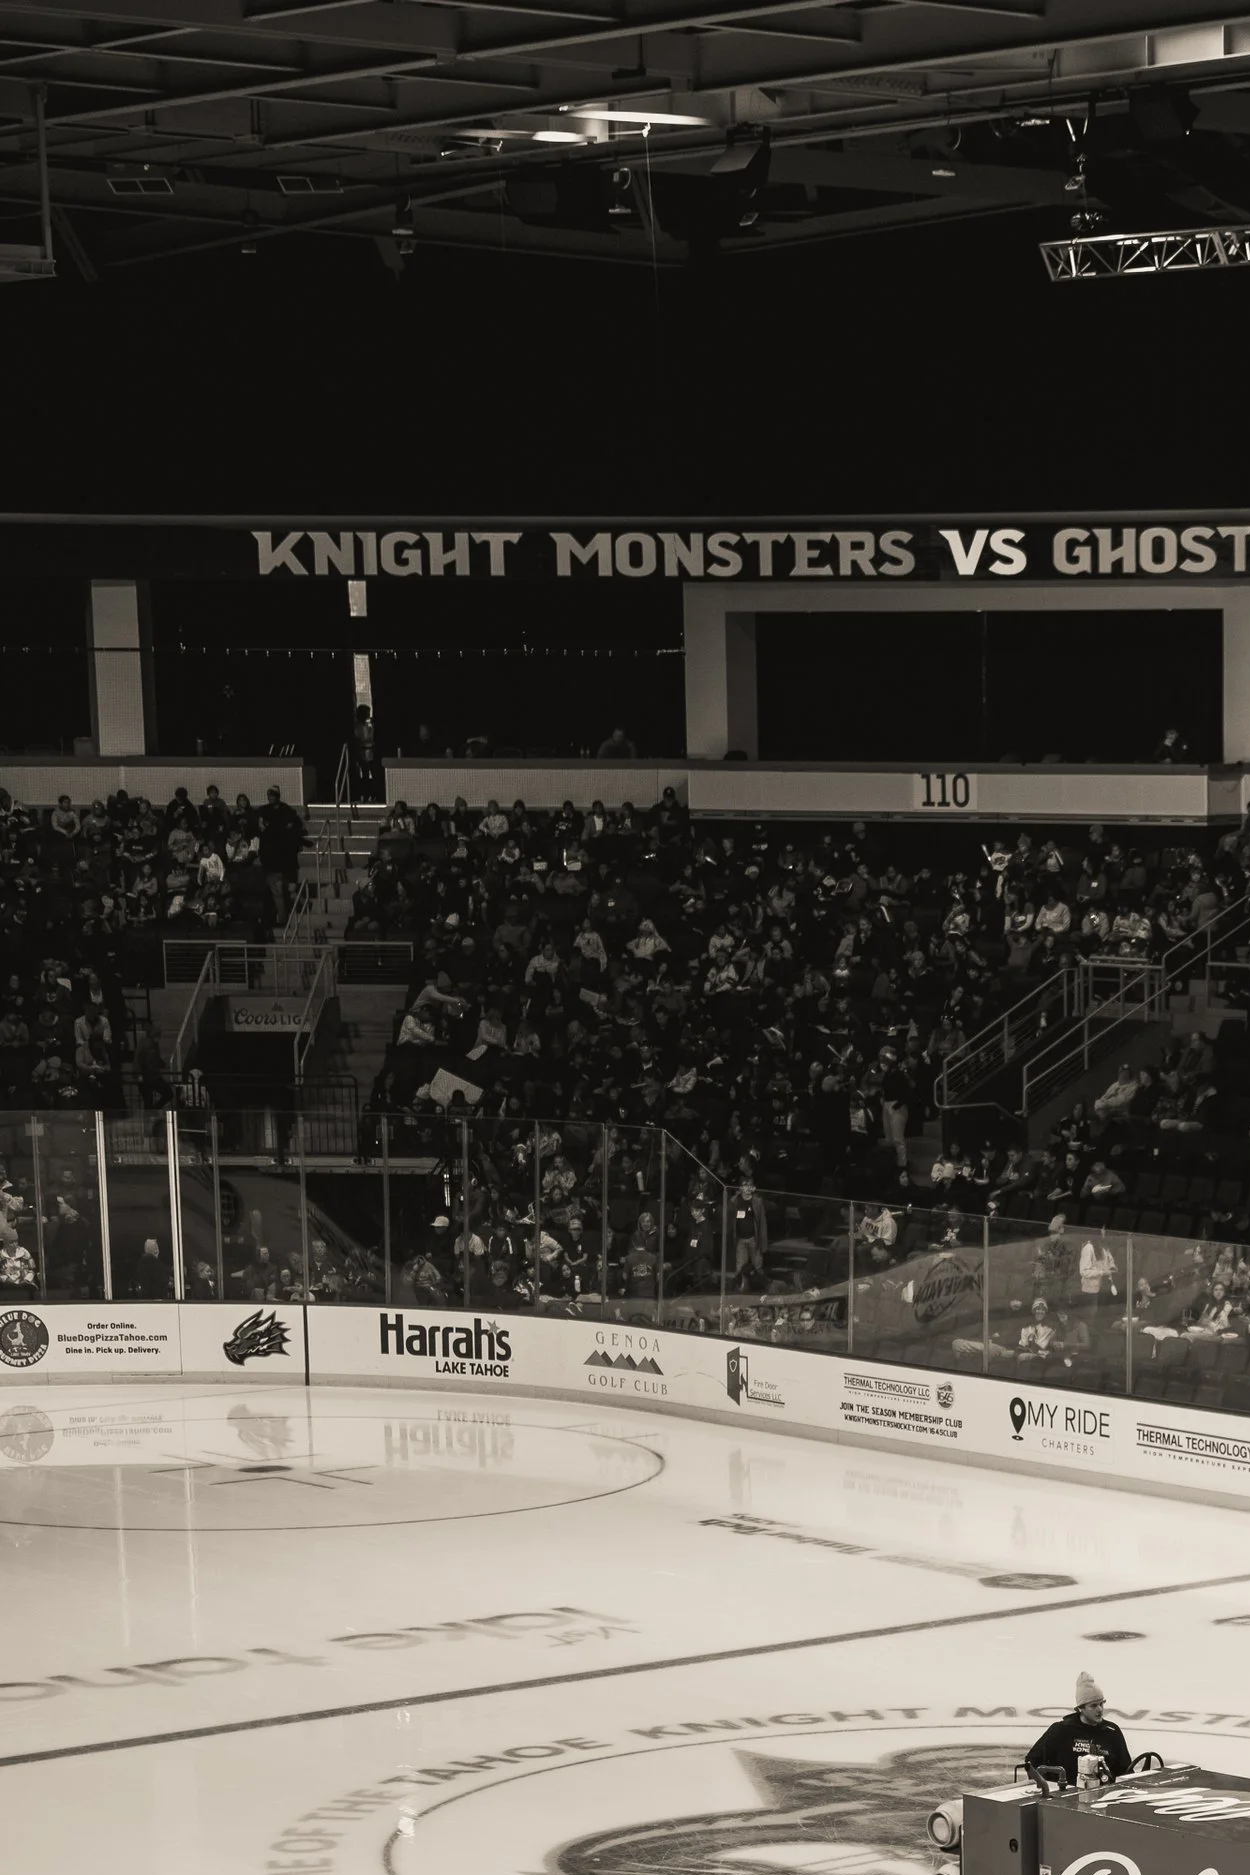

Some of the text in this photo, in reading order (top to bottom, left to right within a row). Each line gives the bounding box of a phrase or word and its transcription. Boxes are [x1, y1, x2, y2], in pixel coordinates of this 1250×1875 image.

[251, 531, 523, 577] KNIGHT
[550, 531, 917, 579] MONSTERS
[938, 529, 1028, 577] VS
[920, 773, 971, 808] 110
[234, 1008, 278, 1026] Coors
[87, 1322, 137, 1330] Order Online.
[57, 1333, 168, 1343] BlueDogPizzaTahoe.com
[595, 1331, 660, 1353] GENOA
[128, 1346, 161, 1355] Delivery.
[435, 1361, 509, 1378] LAKE TAHOE
[588, 1373, 668, 1395] GOLF CLUB
[844, 1376, 874, 1389] THERMAL
[875, 1381, 917, 1396] TECHNOLOGY
[918, 1387, 930, 1398] LLC
[839, 1401, 963, 1429] JOIN THE SEASON MEMBERSHIP CLUB
[1027, 1400, 1111, 1438] MY RIDE
[1041, 1438, 1095, 1456] CHARTERS
[1136, 1428, 1183, 1448] THERMAL
[627, 1706, 930, 1739] KNIGHT
[377, 1737, 614, 1787] TAHOE
[297, 1789, 402, 1823] THE
[269, 1828, 345, 1854] OF
